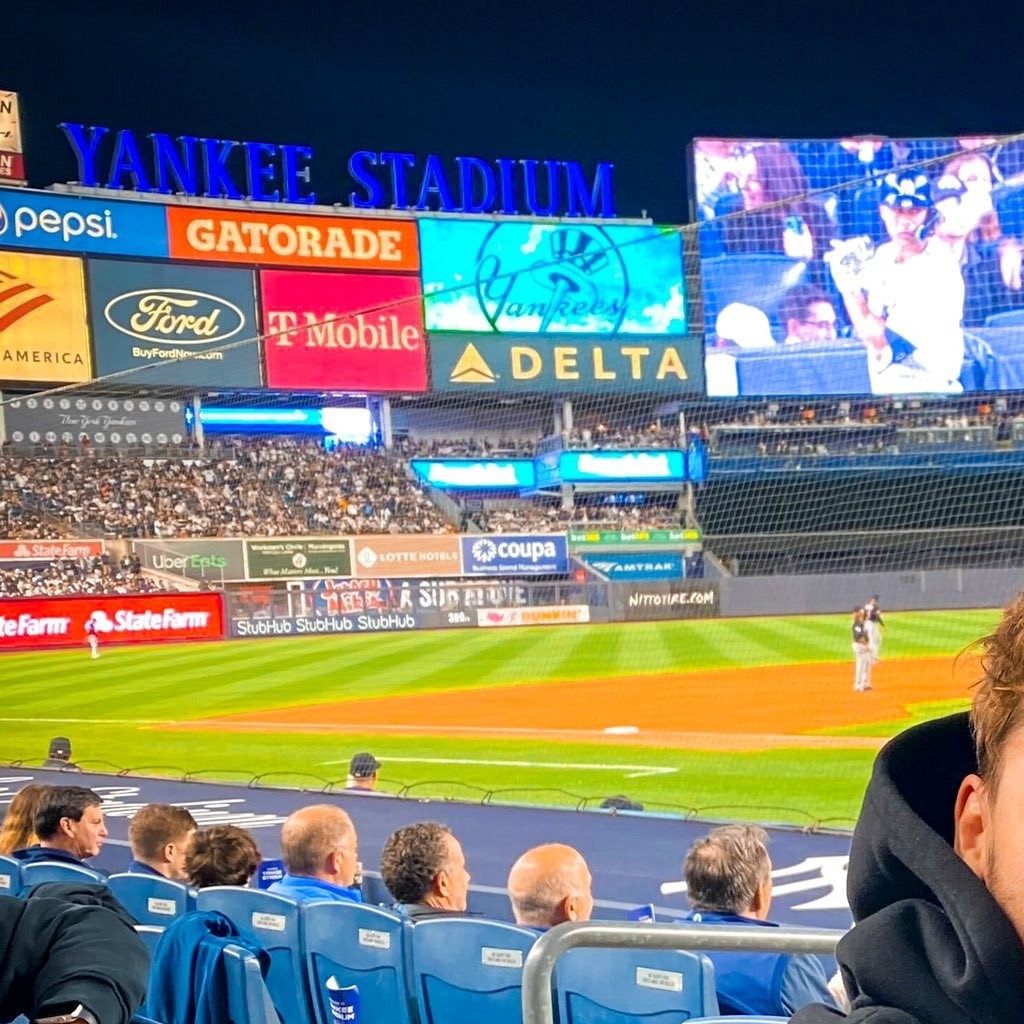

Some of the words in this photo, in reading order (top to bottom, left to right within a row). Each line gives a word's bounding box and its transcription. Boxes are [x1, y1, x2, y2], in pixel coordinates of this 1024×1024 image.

[57, 122, 316, 206] YANKEE
[348, 150, 617, 218] STADIUM
[186, 218, 402, 261] GATORADE
[130, 295, 221, 336] Ford
[3, 350, 84, 365] AMERICA
[510, 346, 688, 381] DELTA
[153, 555, 188, 568] Uber
[190, 555, 226, 568] Eats
[380, 553, 413, 562] LOTTE
[418, 552, 457, 561] HOTELS
[498, 540, 557, 562] coupa
[614, 563, 671, 572] AMTRAK
[237, 619, 292, 636] StubHub
[296, 617, 352, 632] StubHub
[357, 614, 415, 631] StubHub
